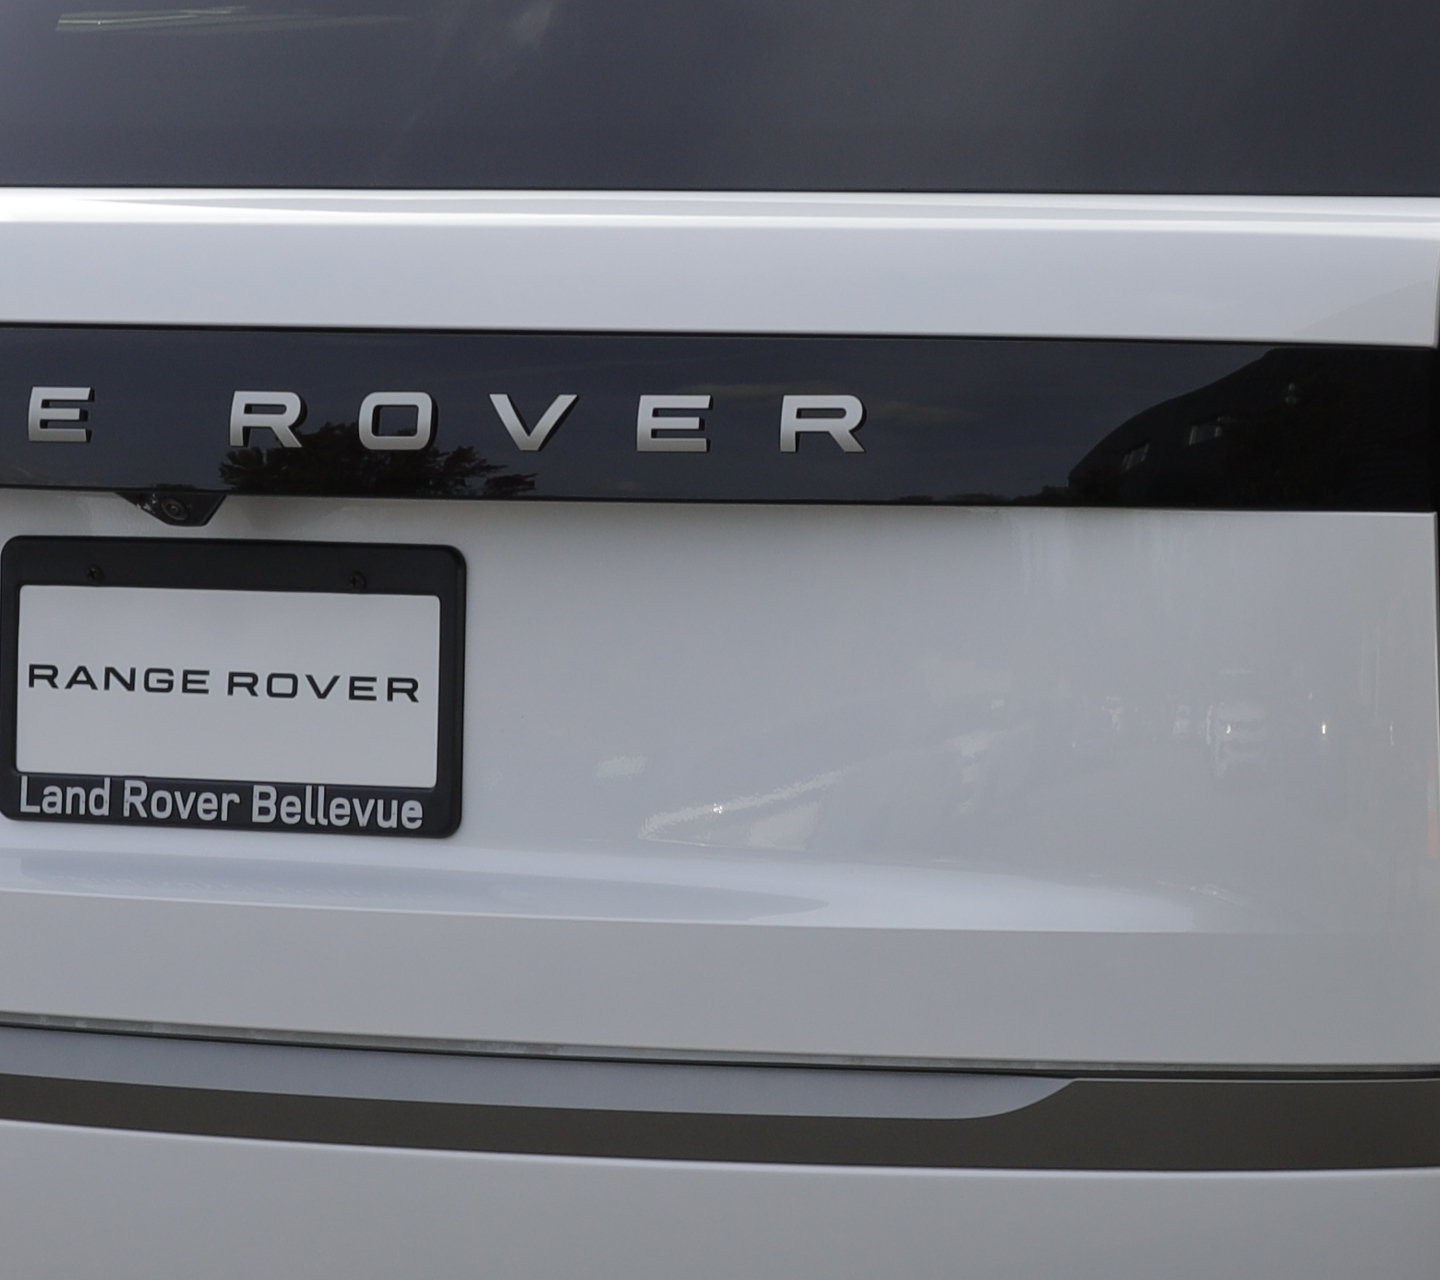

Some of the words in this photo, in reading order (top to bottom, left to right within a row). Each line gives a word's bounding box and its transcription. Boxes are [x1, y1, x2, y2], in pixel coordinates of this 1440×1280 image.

[228, 390, 867, 453] ROVER
[28, 663, 210, 695] RANGE
[227, 671, 420, 704] ROVER
[19, 774, 111, 817] Land
[123, 779, 241, 821] Rover
[251, 784, 424, 830] Bellevue
